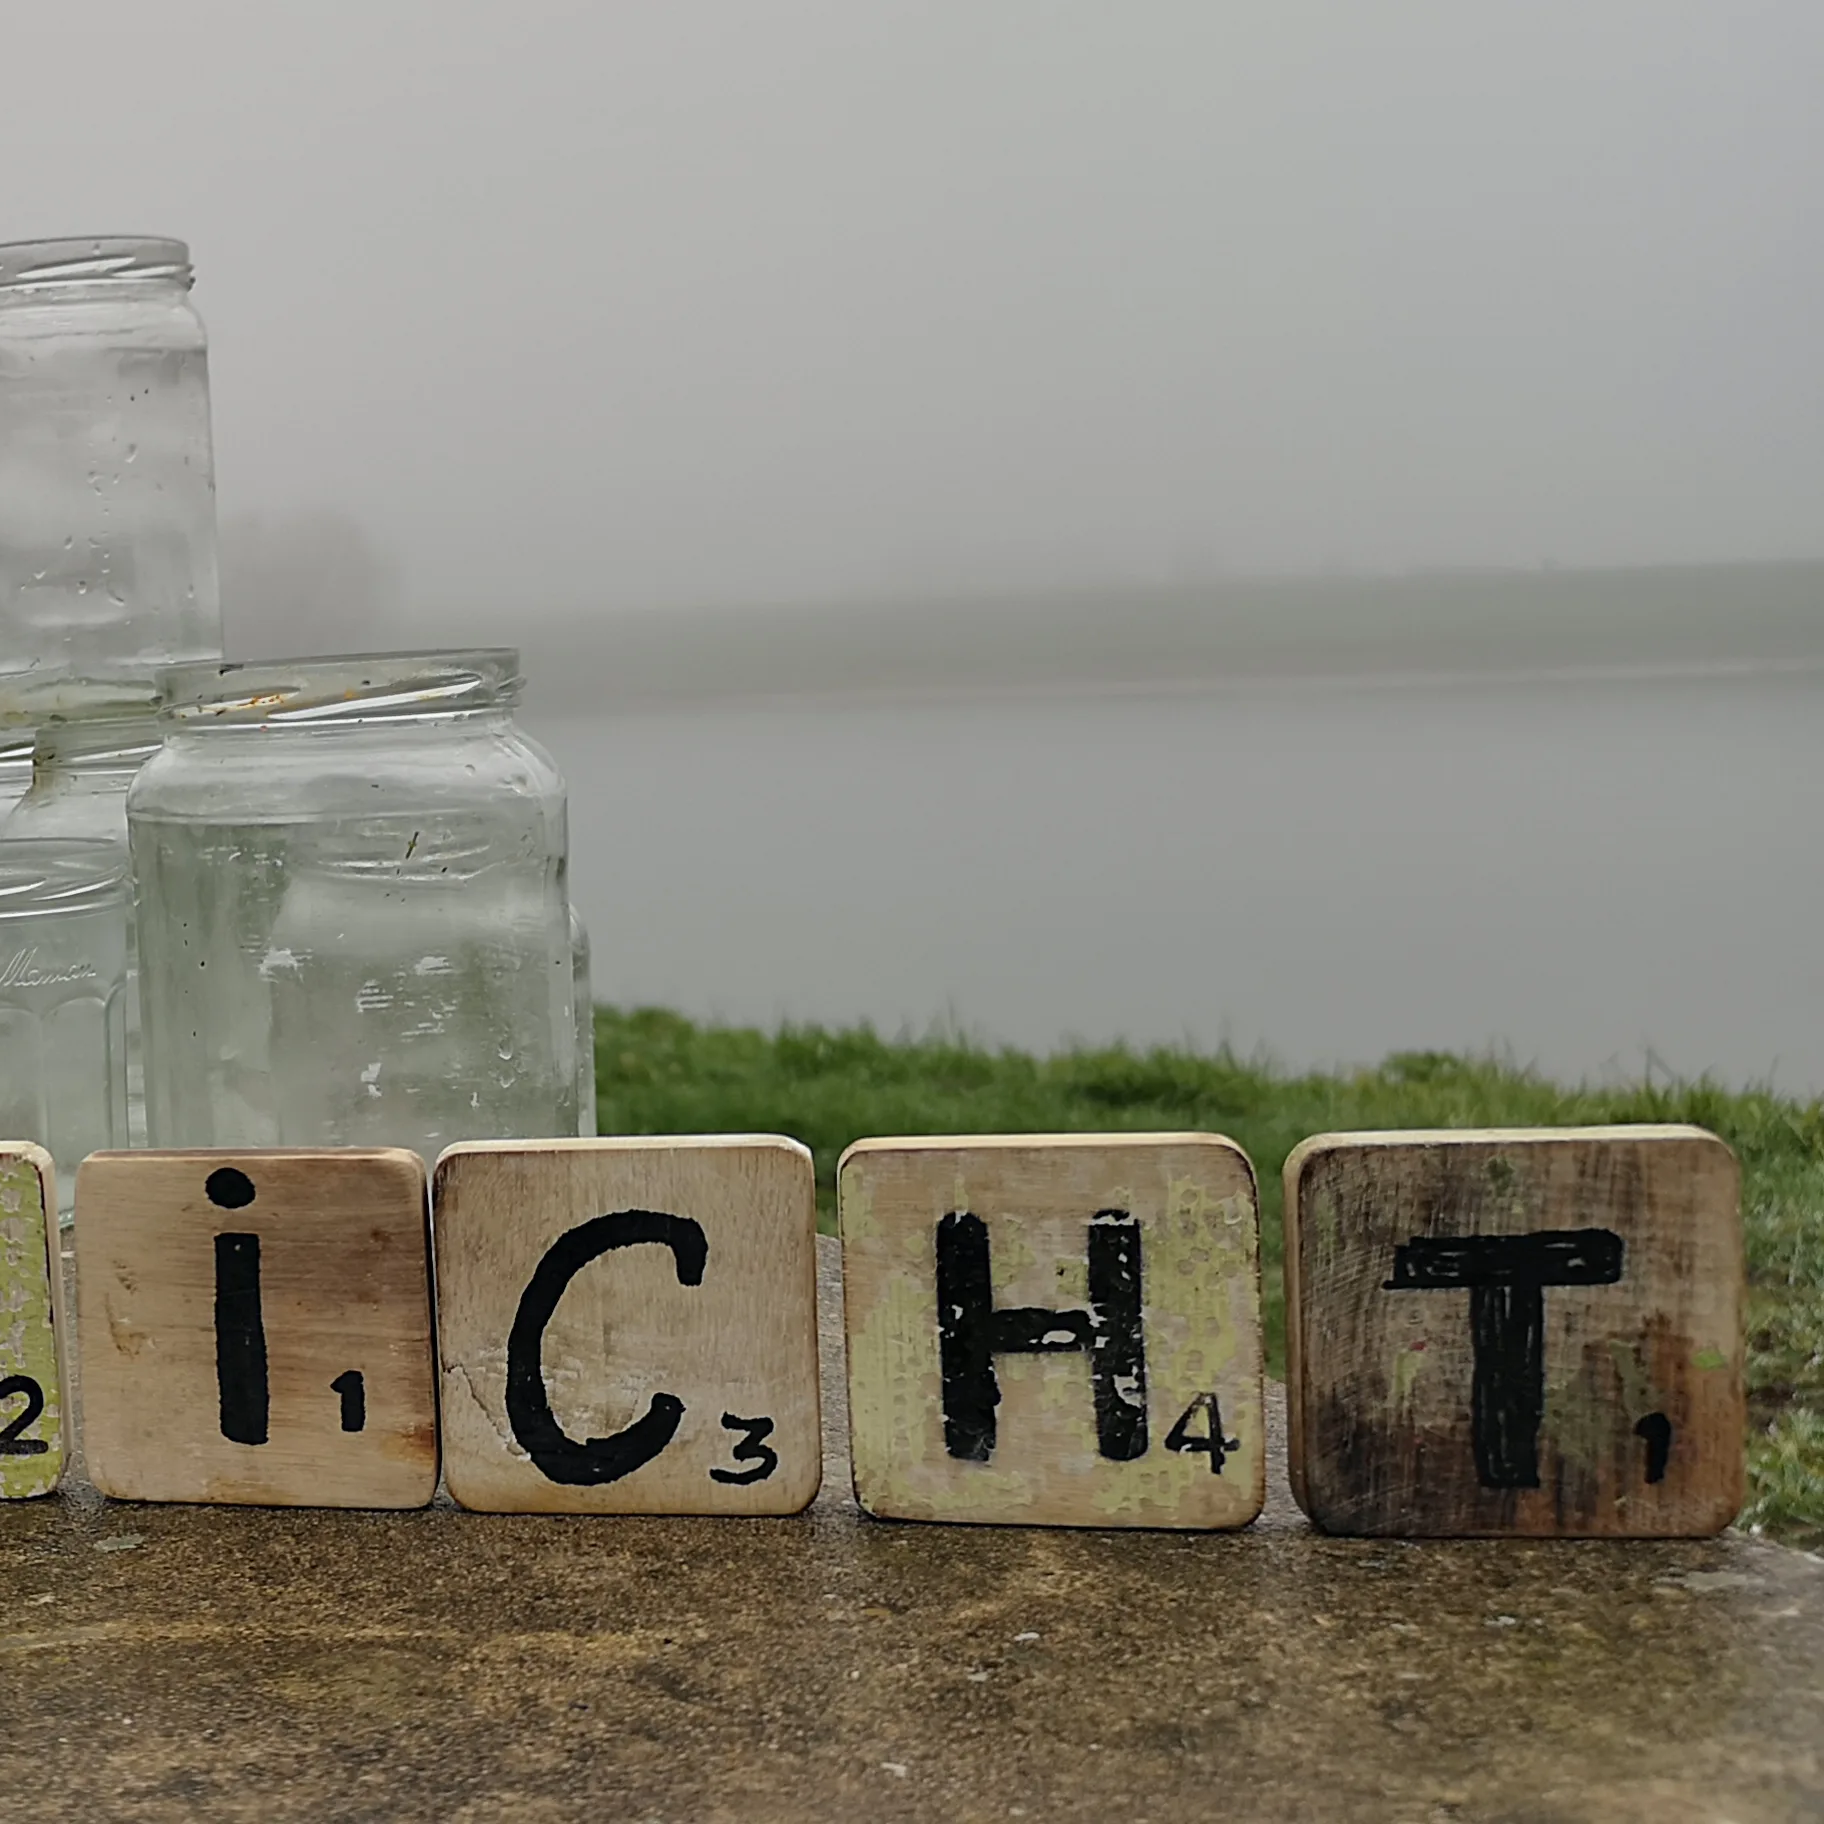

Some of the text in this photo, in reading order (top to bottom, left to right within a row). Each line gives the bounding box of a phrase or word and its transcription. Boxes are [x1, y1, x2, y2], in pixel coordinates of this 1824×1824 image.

[330, 1371, 366, 1433] 1
[1164, 1391, 1240, 1475] 4
[710, 1413, 778, 1485] 3
[1635, 1411, 1671, 1484] 1
